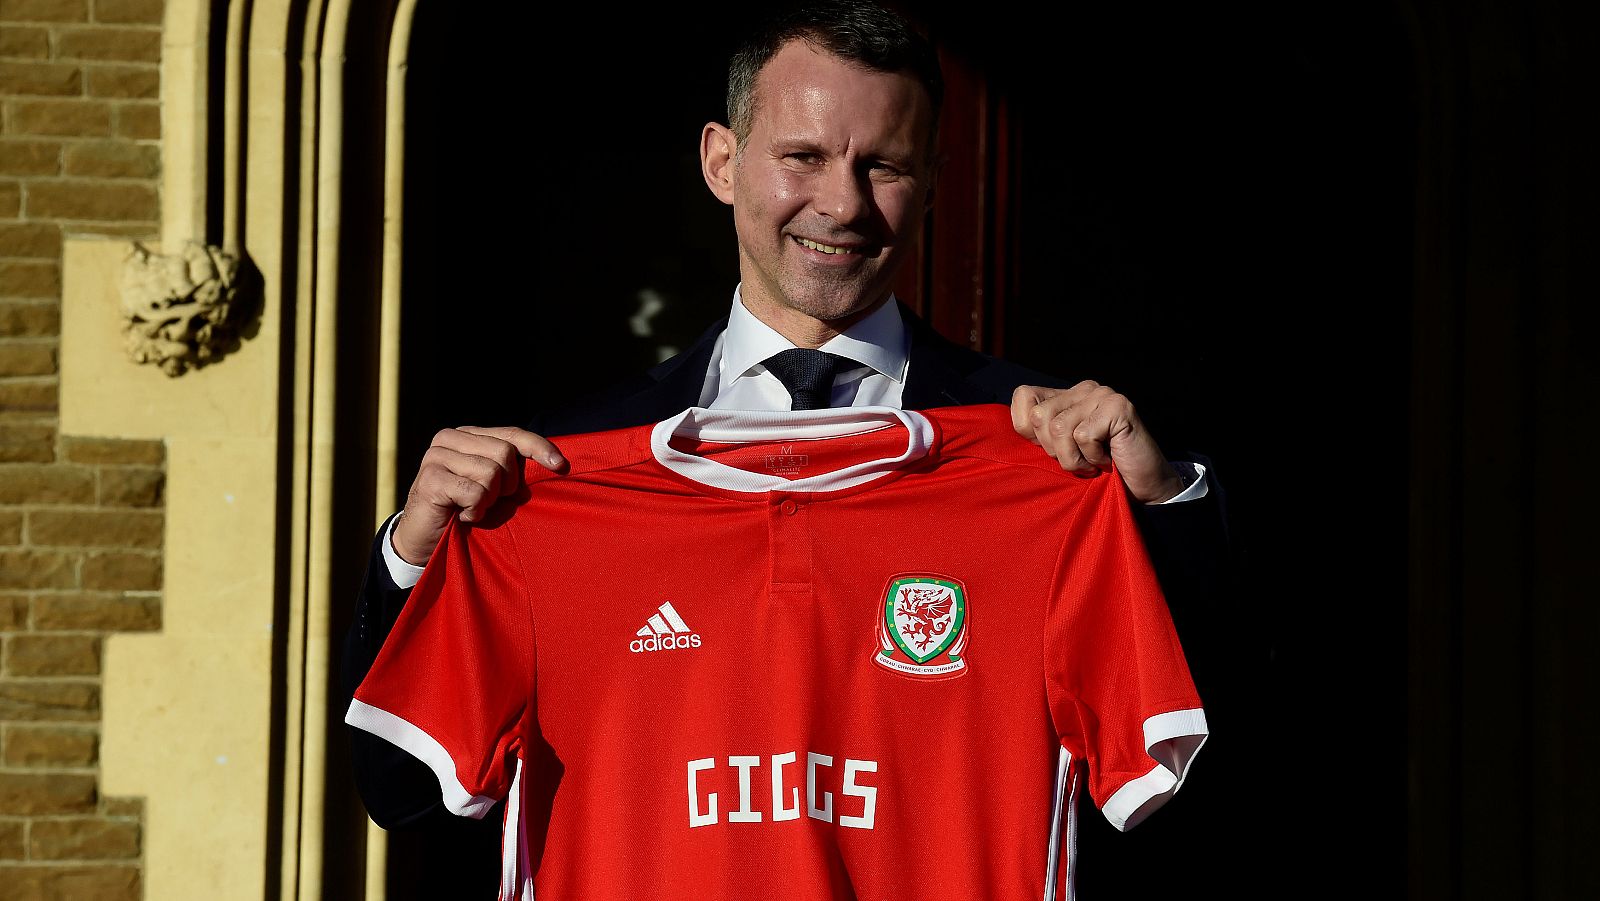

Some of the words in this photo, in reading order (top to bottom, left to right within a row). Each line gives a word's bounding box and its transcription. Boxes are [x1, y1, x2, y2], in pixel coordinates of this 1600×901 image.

[780, 445, 793, 455] M
[629, 632, 702, 653] adidas
[687, 751, 878, 830] GIGGS
